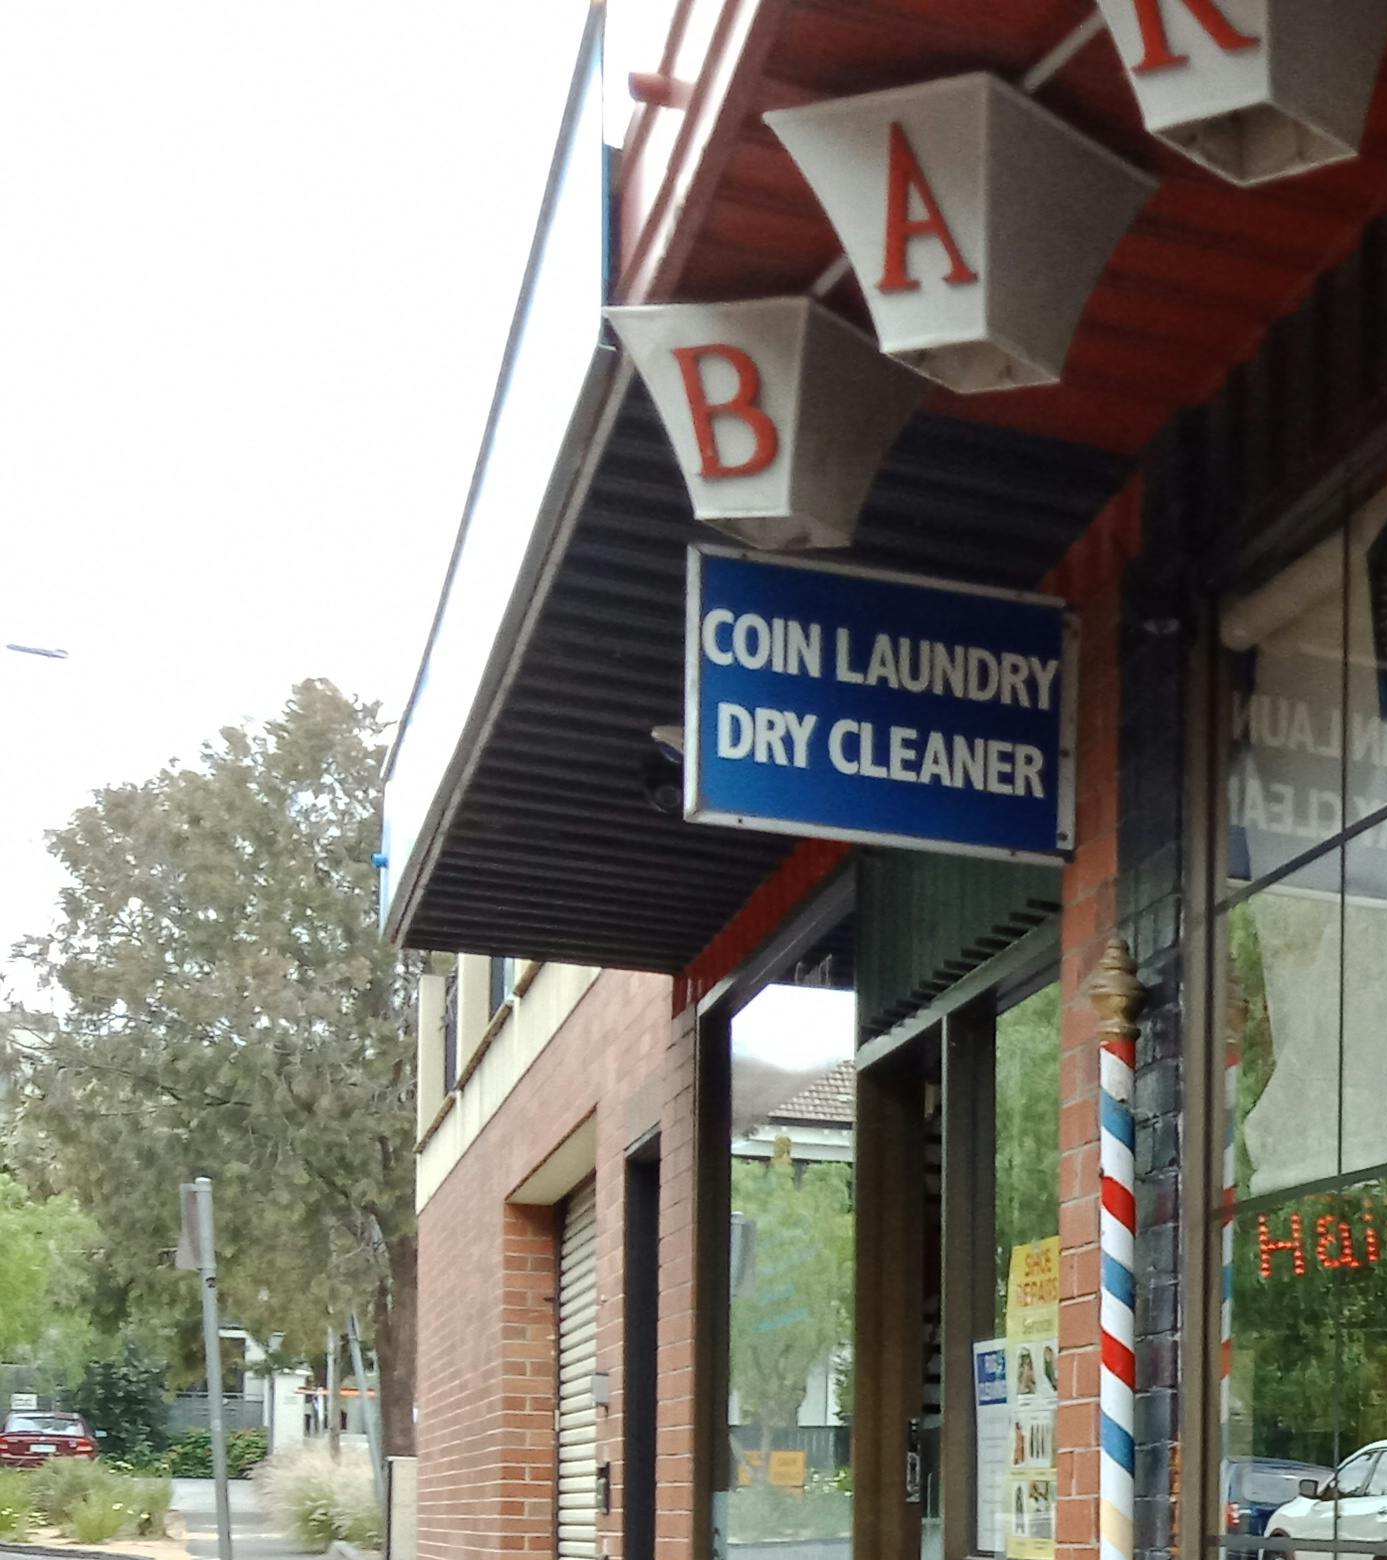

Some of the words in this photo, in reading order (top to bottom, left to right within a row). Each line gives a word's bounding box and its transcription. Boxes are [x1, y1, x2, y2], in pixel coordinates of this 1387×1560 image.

[702, 608, 822, 679] COIN
[836, 626, 1060, 711] LAUNDRY
[717, 701, 819, 769] DRY
[828, 718, 1045, 799] CLEANER
